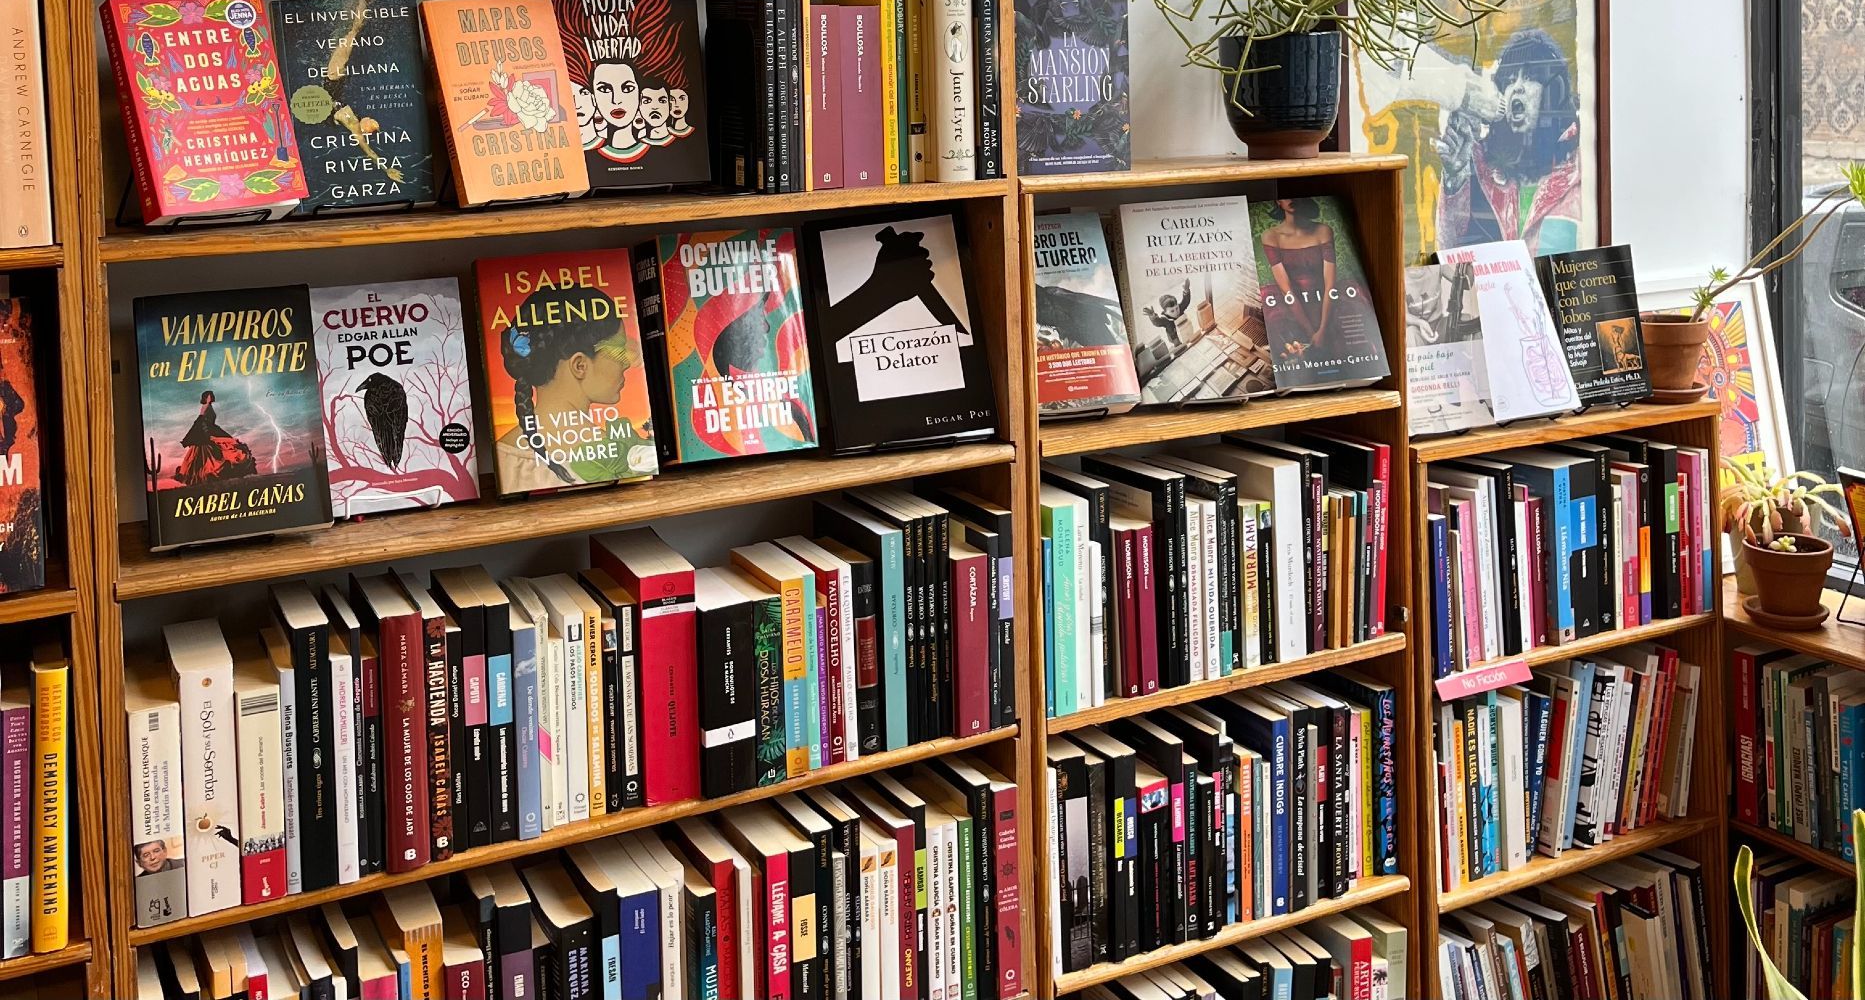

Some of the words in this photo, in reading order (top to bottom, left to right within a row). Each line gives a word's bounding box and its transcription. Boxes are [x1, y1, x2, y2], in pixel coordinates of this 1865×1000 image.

[285, 12, 304, 23] EL
[311, 7, 409, 22] INVENCIBLE
[458, 6, 532, 33] MAPAS
[590, 17, 629, 36] VIDA
[778, 9, 786, 25] EL
[983, 0, 991, 43] GUERRA
[165, 28, 233, 48] ENTRE
[316, 35, 384, 49] VERANO
[456, 37, 547, 66] DIFUSOS
[584, 39, 642, 62] LIBERTAD
[778, 29, 786, 69] ALEPH
[1063, 32, 1077, 47] LA
[12, 27, 28, 97] ANDREW
[184, 51, 223, 69] DOS
[308, 67, 334, 78] DE
[337, 62, 399, 76] LILIANA
[984, 47, 993, 100] MUNDIAL
[1030, 45, 1110, 76] MANSIÓN
[176, 73, 242, 93] AGUAS
[950, 69, 965, 103] Jane
[1028, 75, 1112, 104] STARLING
[951, 107, 965, 142] Eyre
[982, 104, 996, 117] Z
[18, 107, 35, 191] CARNEGIE
[186, 131, 258, 150] CRISTINA
[311, 131, 411, 149] CRISTINA
[472, 127, 569, 156] CRISTINA
[983, 122, 991, 156] BROOKS
[184, 146, 268, 166] HENRÍQUEZ
[325, 156, 402, 174] RIVERA
[490, 154, 564, 187] GARCÍA
[331, 182, 400, 198] GARZA
[1160, 216, 1215, 230] CARLOS
[680, 240, 758, 267] OCTAVIA
[1147, 234, 1183, 247] RUIZ
[1187, 231, 1233, 244] ZAFÓN
[504, 265, 609, 294] ISABEL
[690, 264, 780, 298] BUTLER
[1552, 260, 1598, 275] Mujeres
[368, 293, 381, 302] EL
[1266, 286, 1358, 306] GÓTICO
[1556, 281, 1577, 292] que
[1580, 274, 1616, 287] corren
[491, 296, 629, 330] ALLENDE
[1559, 297, 1578, 308] con
[1582, 292, 1598, 304] los
[161, 307, 293, 346] VAMPIROS
[323, 303, 429, 330] CUERVO
[1561, 311, 1591, 324] lobos
[338, 330, 378, 343] EDGAR
[380, 327, 418, 339] ALLAN
[858, 340, 876, 355] El
[882, 332, 951, 352] Corazón
[149, 361, 171, 379] en
[177, 349, 212, 383] EL
[220, 341, 308, 378] NORTE
[346, 341, 414, 370] POE
[876, 353, 939, 371] Delator
[692, 384, 717, 410] LA
[722, 376, 799, 406] ESTIRPE
[524, 414, 546, 432] EL
[549, 406, 619, 428] VIENTO
[706, 410, 731, 433] DE
[736, 401, 793, 429] LILITH
[516, 426, 602, 450] CONOCE
[609, 423, 632, 440] MI
[535, 442, 618, 468] NOMBRE
[175, 490, 242, 518] ISABEL
[247, 483, 305, 508] CAÑAS
[1245, 519, 1257, 589] MURAKAMI
[1560, 526, 1568, 572] Llámame
[829, 580, 837, 616] PAULO
[969, 567, 977, 607] CORTÁZAR
[785, 588, 803, 664] CARAMELO
[430, 643, 441, 655] LA
[830, 620, 839, 666] COELHO
[428, 661, 445, 726] HACIENDA
[1462, 677, 1476, 689] No
[1479, 670, 1507, 685] Ficción
[200, 710, 216, 732] Sol
[285, 705, 294, 730] Milena
[1468, 709, 1476, 737] NADIE
[284, 732, 294, 769] Busquets
[434, 735, 446, 775] ISABEL
[1276, 735, 1284, 776] CUMBRE
[1335, 736, 1343, 751] LA
[1468, 739, 1477, 751] ES
[203, 751, 217, 801] Sombra
[1335, 754, 1343, 788] SANTA
[1468, 754, 1478, 785] ILEGAL
[43, 753, 57, 828] DEMOCRACY
[436, 779, 449, 815] CAÑAS
[1276, 780, 1285, 815] ÍNDIGO
[1335, 792, 1343, 836] MUERTE
[44, 837, 58, 915] AWAKENING
[771, 881, 788, 925] LLÉVAME
[771, 945, 788, 974] CASA
